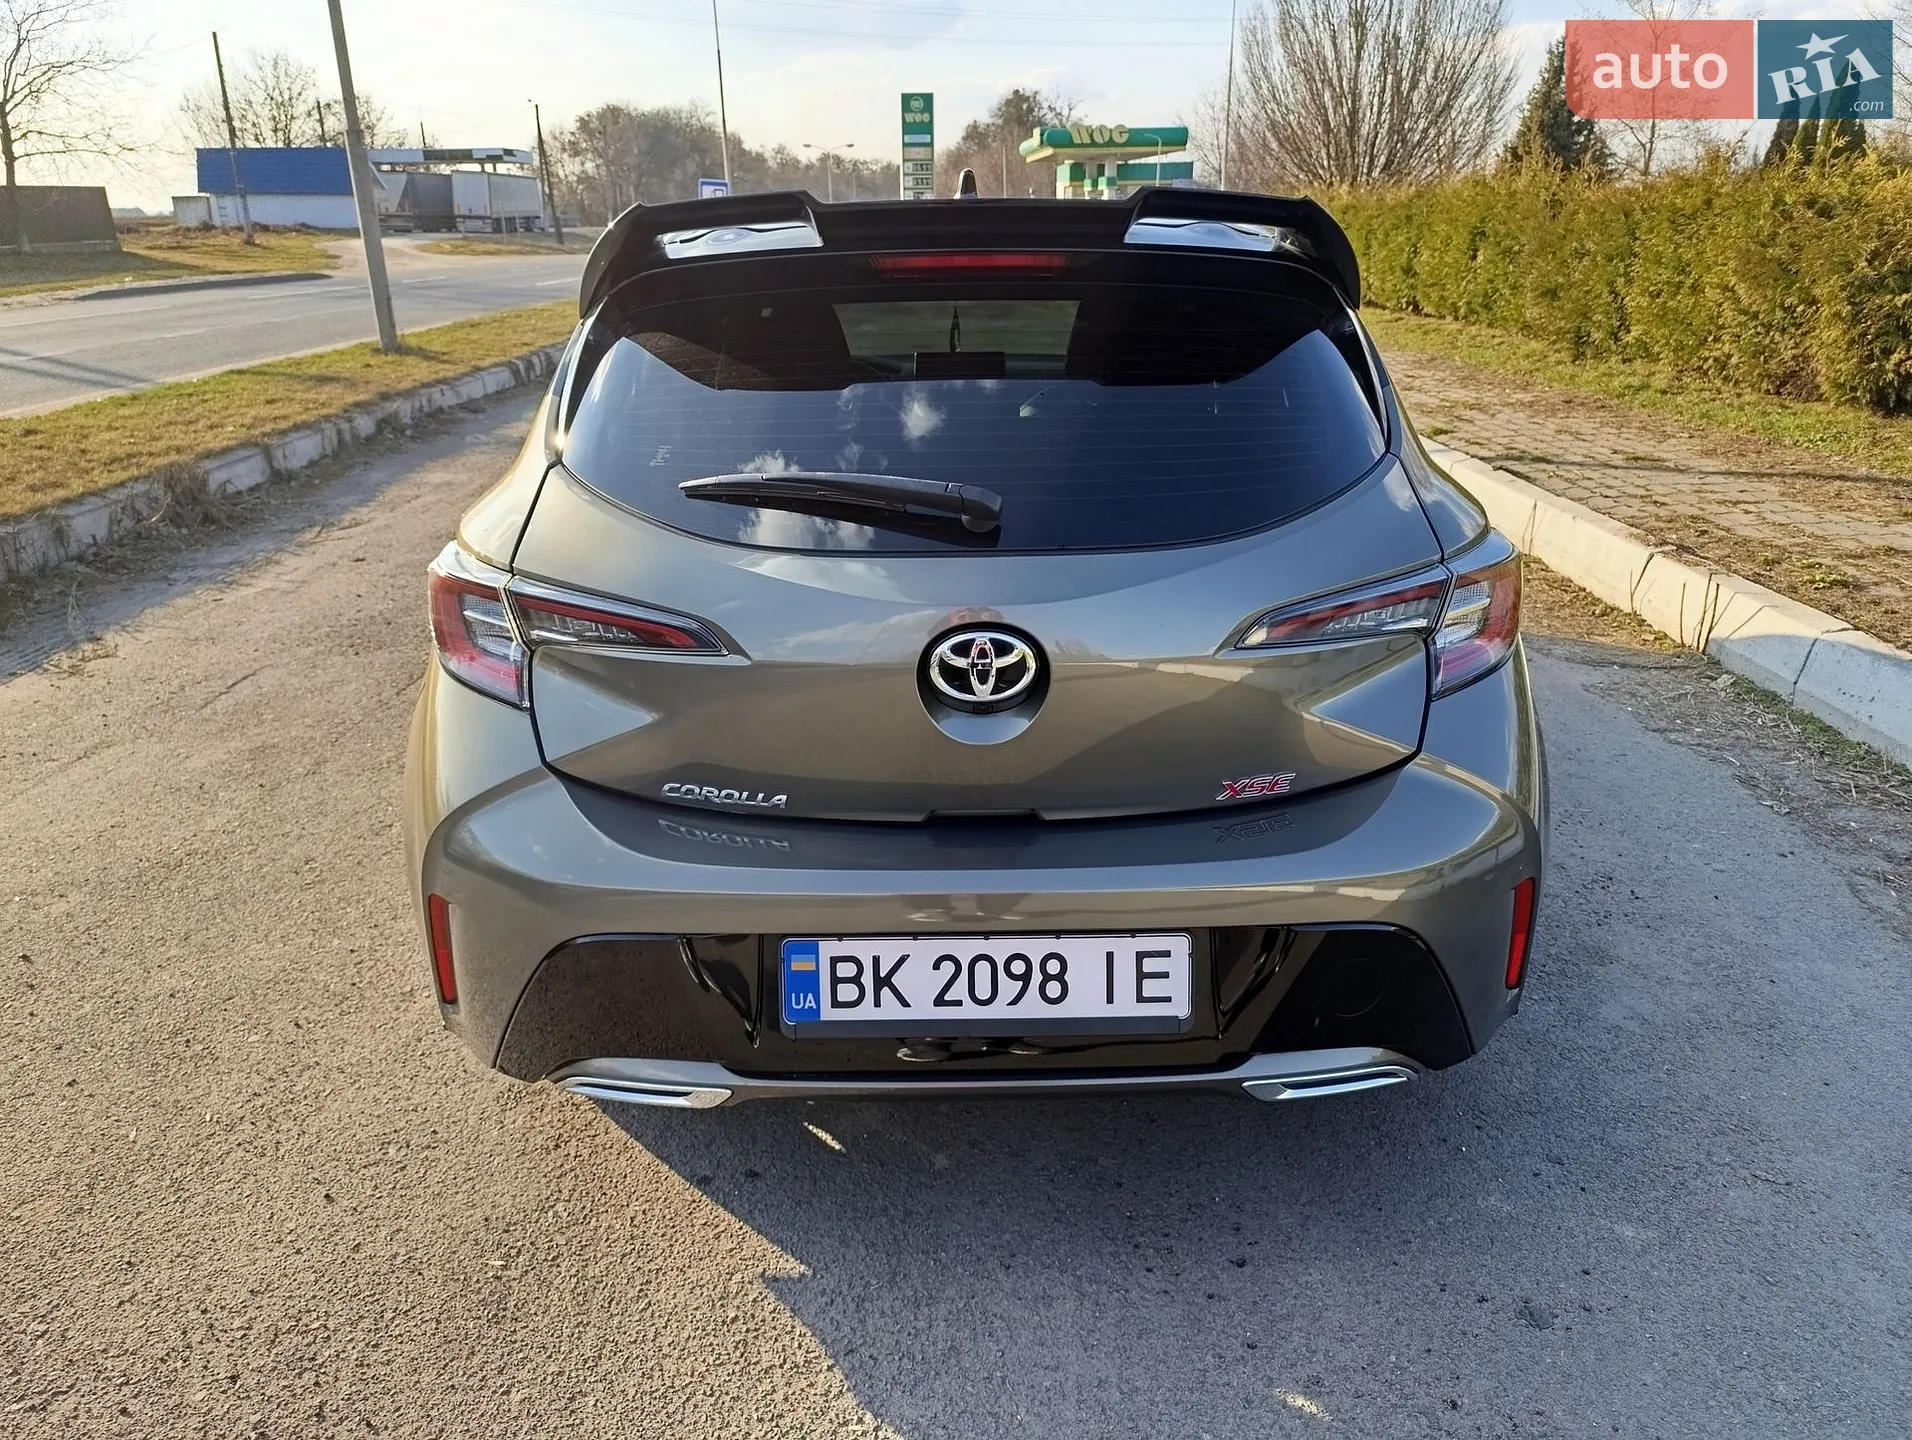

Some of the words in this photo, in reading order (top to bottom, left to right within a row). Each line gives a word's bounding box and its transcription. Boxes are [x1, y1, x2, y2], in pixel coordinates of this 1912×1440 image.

[1066, 122, 1130, 144] WOG
[660, 783, 788, 809] COROLLA
[1215, 772, 1296, 801] XSE
[829, 954, 912, 1009] BK
[932, 952, 1070, 1008] 2098
[1105, 950, 1173, 1006] IE
[791, 992, 818, 1010] UA
